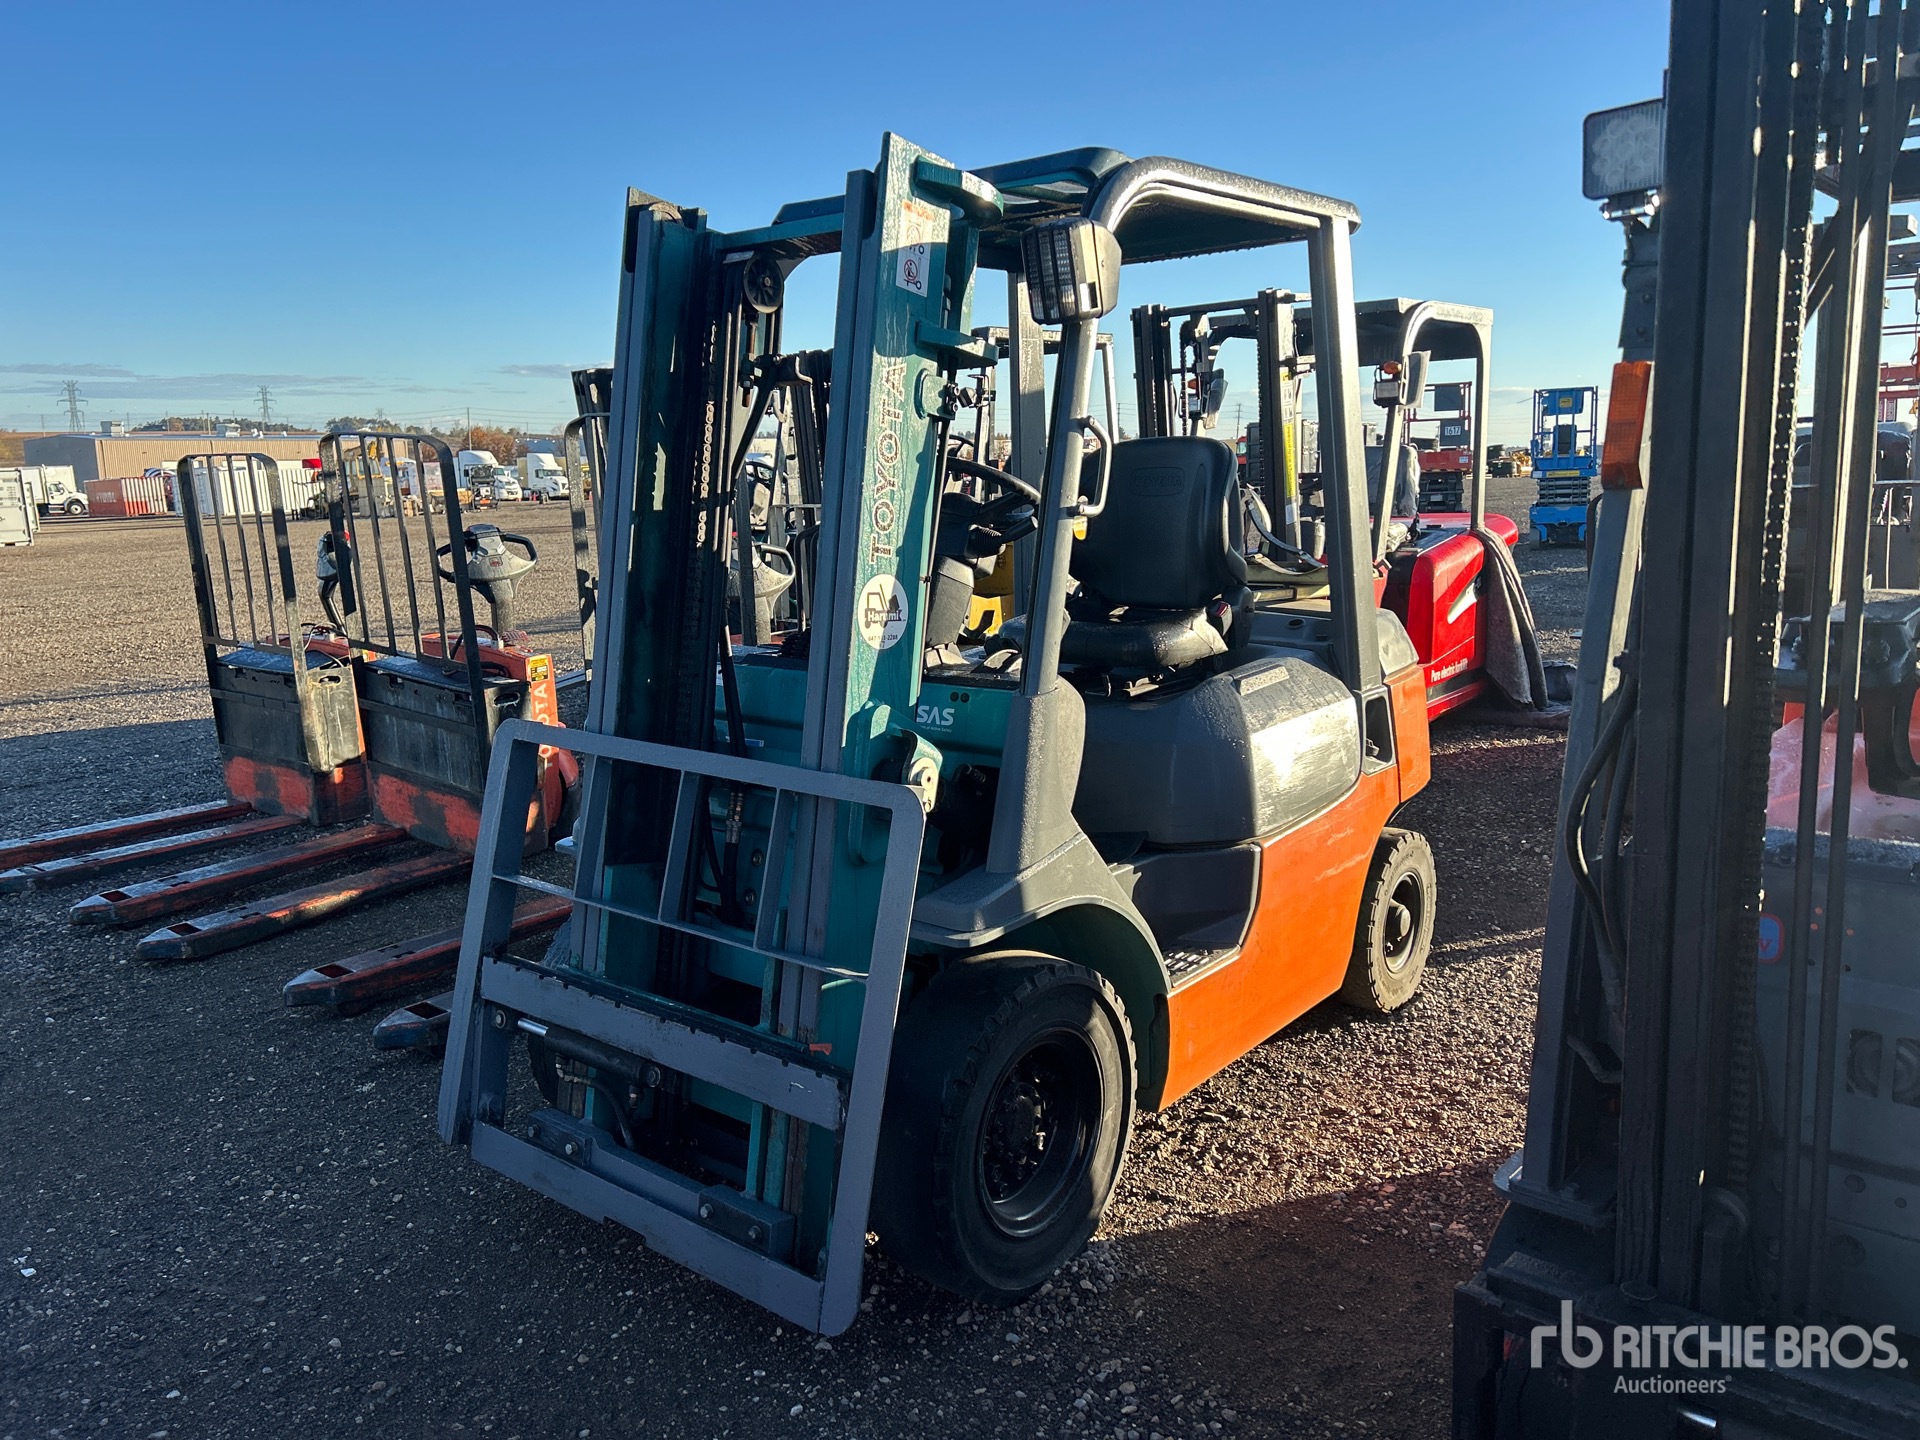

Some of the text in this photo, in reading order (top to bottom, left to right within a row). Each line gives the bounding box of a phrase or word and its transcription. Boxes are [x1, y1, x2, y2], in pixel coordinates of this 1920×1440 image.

[1445, 426, 1461, 435] 1617
[869, 362, 907, 564] TOYOTA
[1135, 475, 1182, 487] TOYOTA
[534, 683, 553, 769] TOOTA
[916, 705, 955, 726] SAS
